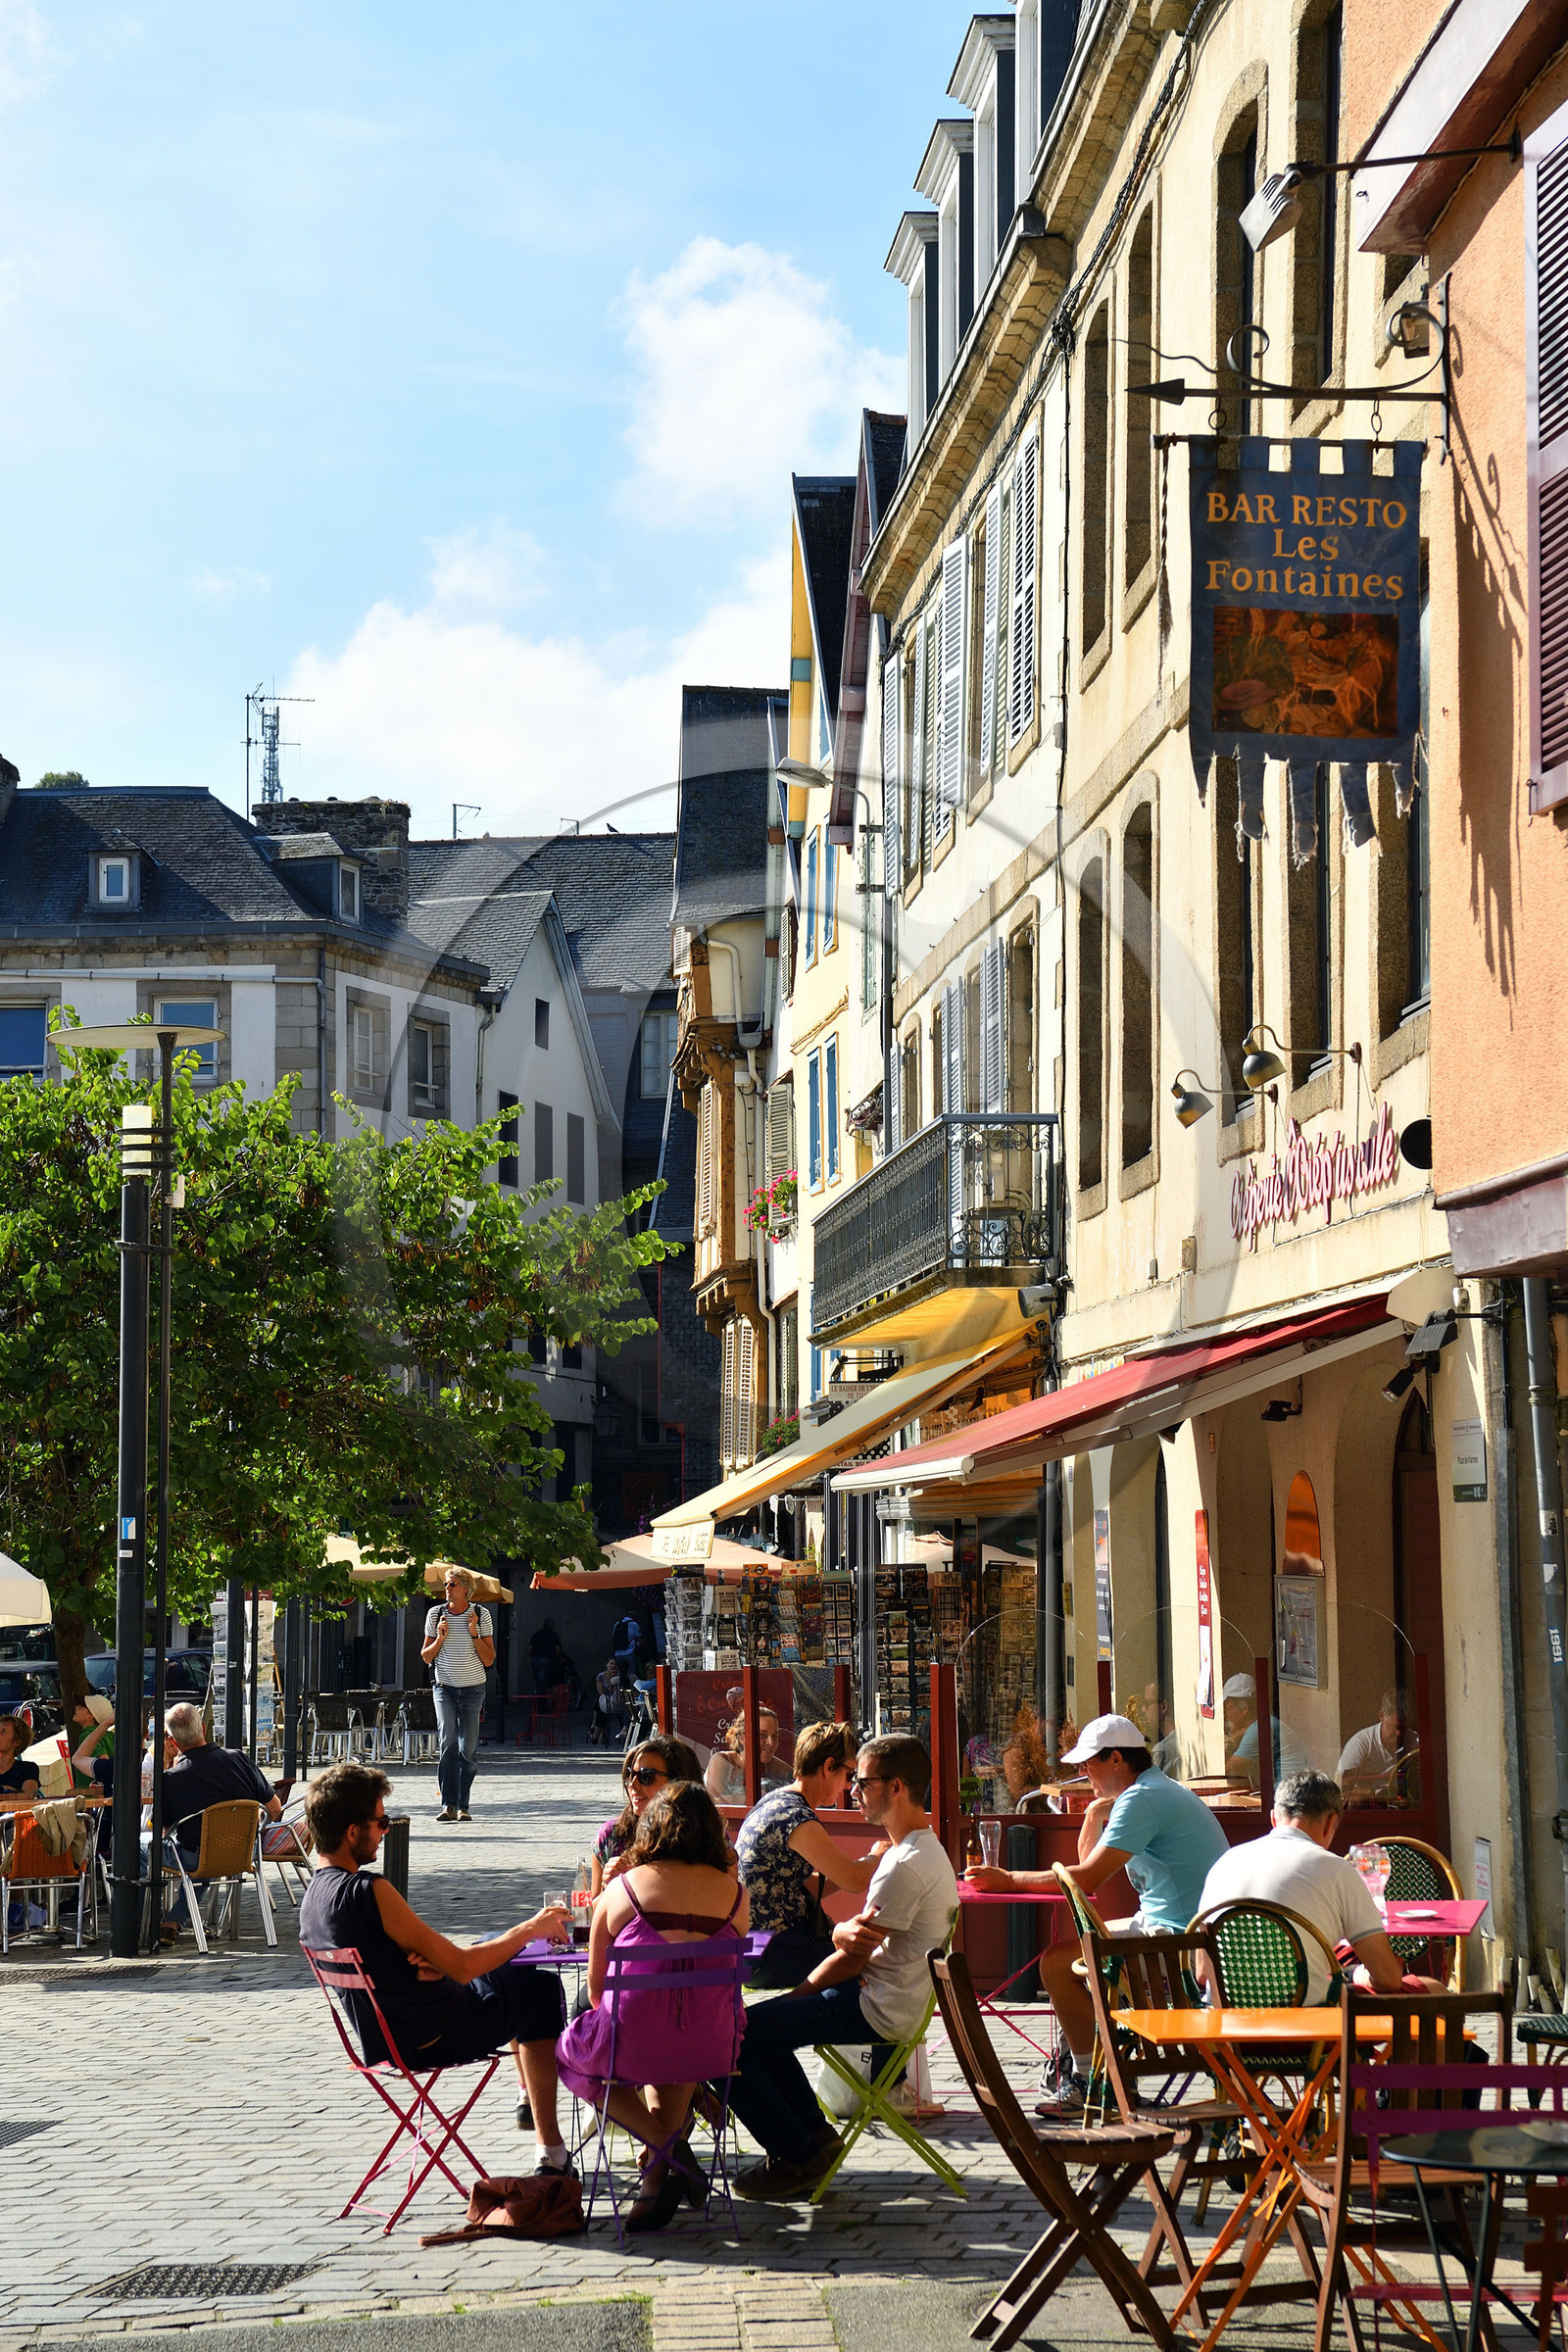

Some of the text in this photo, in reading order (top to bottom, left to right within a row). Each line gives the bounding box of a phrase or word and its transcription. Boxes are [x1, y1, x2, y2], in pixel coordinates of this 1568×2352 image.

[1206, 492, 1407, 529] BAR RESTO
[1272, 528, 1340, 562] Les
[1204, 561, 1403, 600] Fontaines
[1230, 1153, 1284, 1251] Crêperie
[1548, 1628, 1563, 1664] 1991
